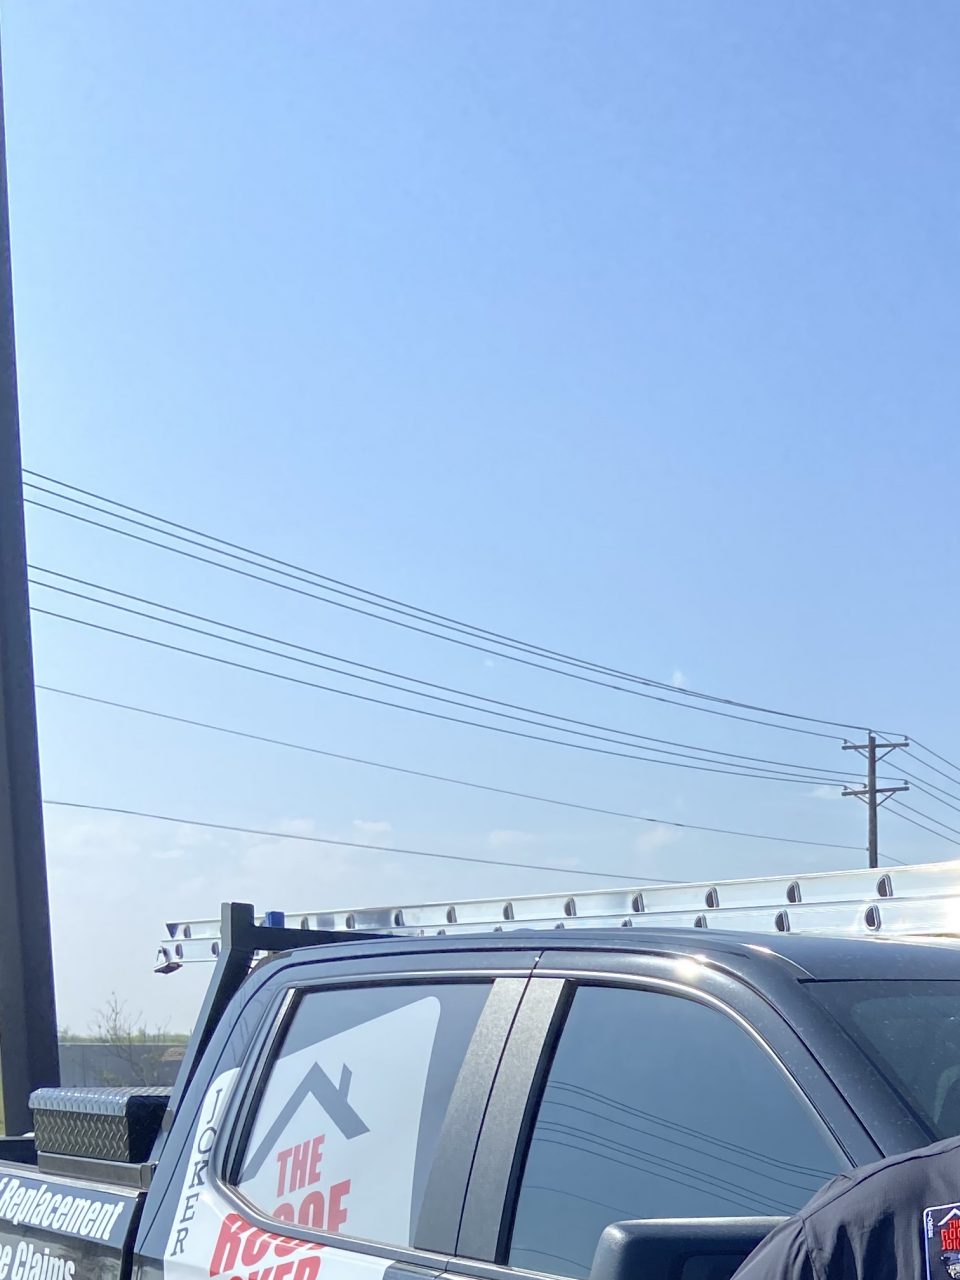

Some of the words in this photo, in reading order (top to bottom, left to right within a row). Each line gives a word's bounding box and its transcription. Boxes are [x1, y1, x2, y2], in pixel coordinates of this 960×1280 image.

[170, 1088, 223, 1257] JOKER
[276, 1133, 326, 1198] THE
[0, 1178, 125, 1241] Replacement
[209, 1178, 352, 1278] ROOF
